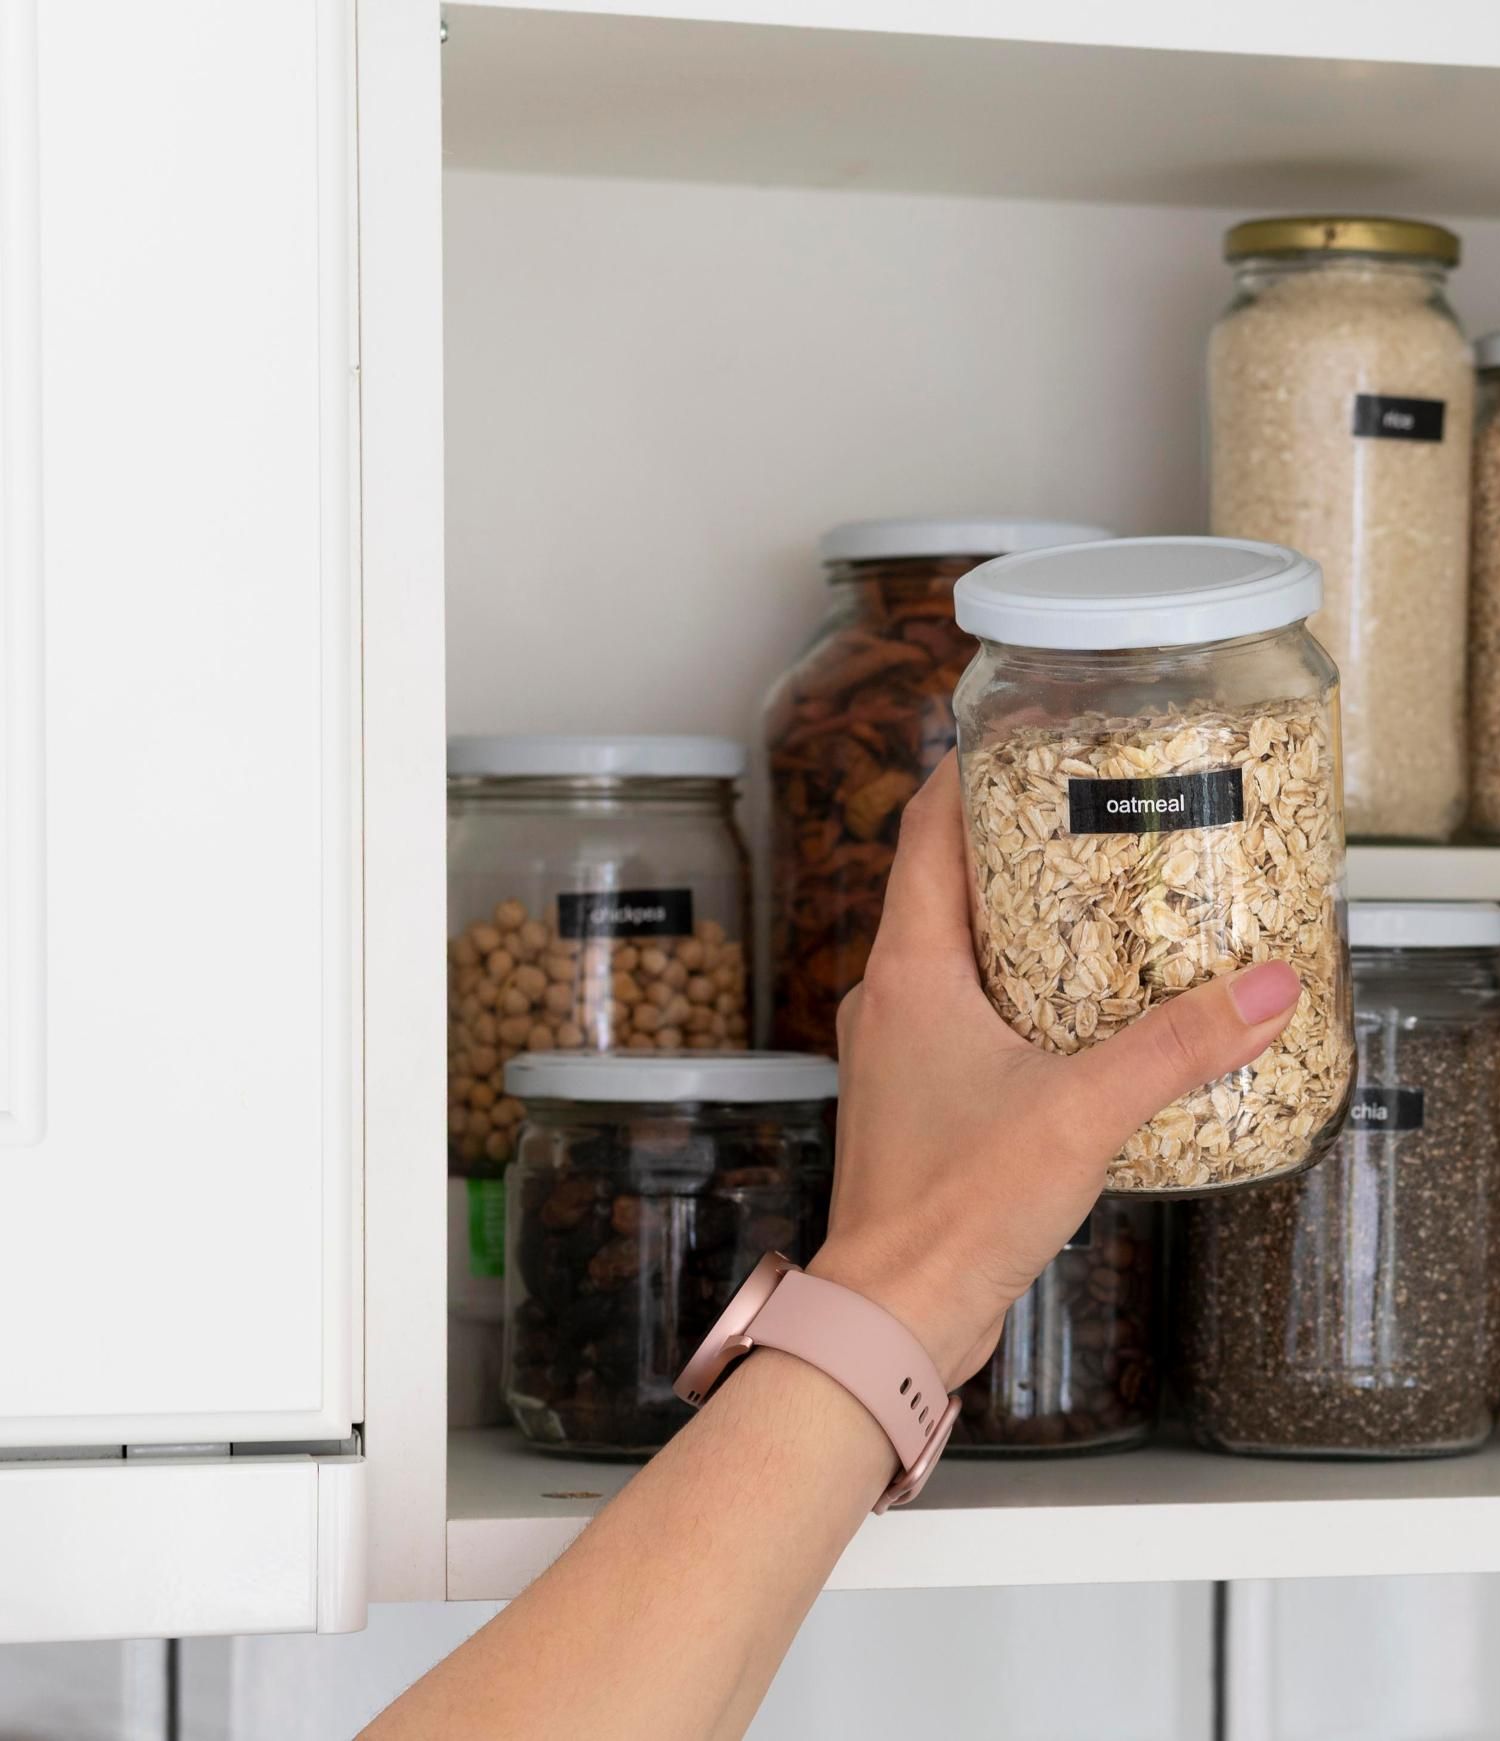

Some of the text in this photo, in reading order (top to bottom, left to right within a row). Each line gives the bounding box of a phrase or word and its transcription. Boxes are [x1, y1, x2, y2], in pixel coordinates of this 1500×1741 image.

[1383, 409, 1415, 431] rice
[1106, 793, 1185, 814] oatmeal
[589, 904, 667, 926] chickpea
[1350, 1103, 1389, 1121] chia
